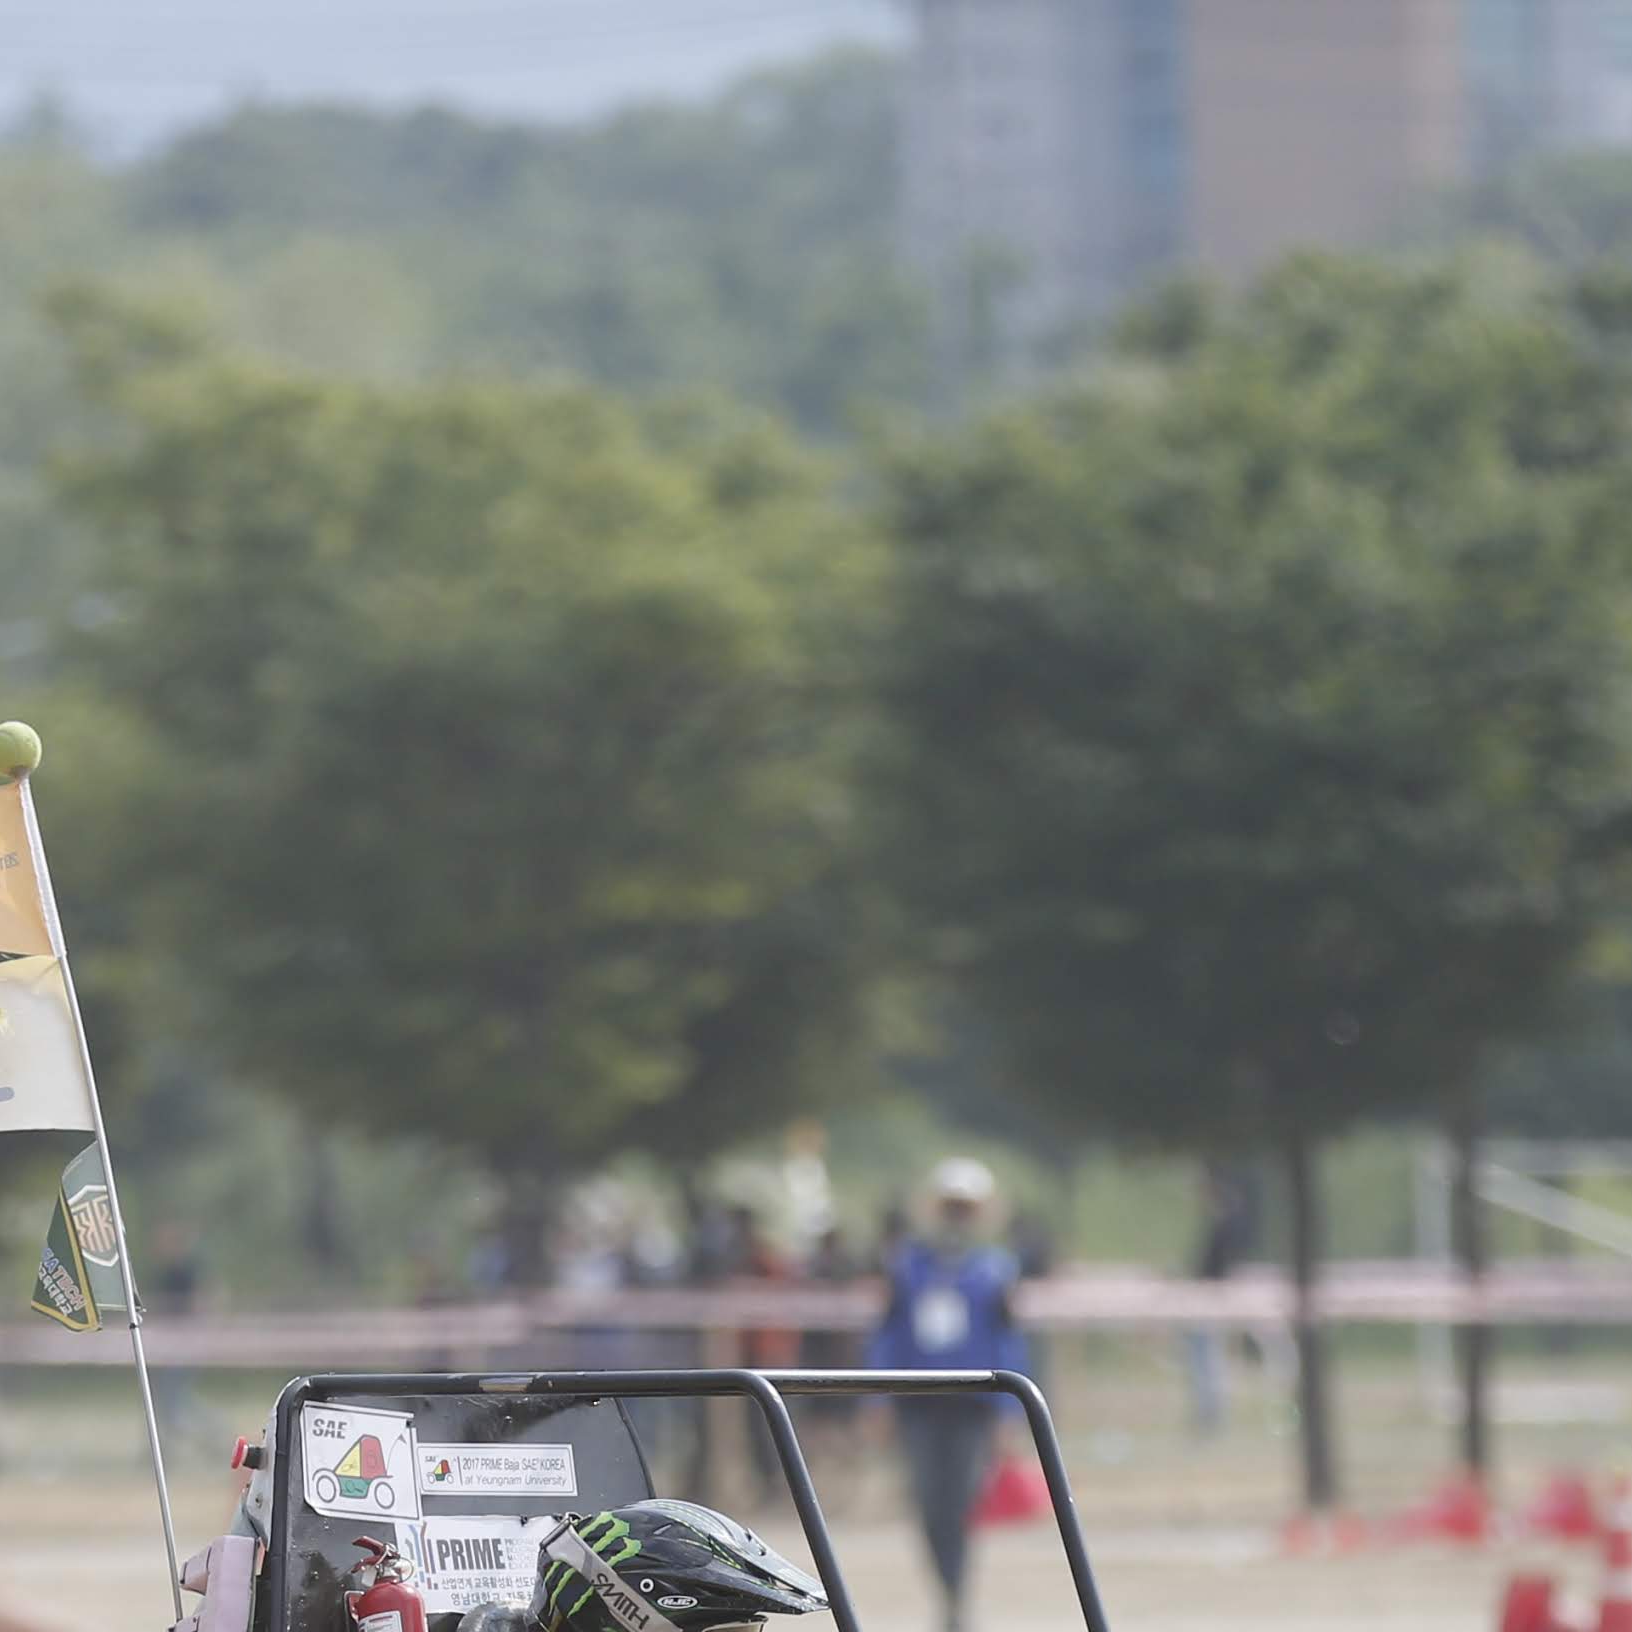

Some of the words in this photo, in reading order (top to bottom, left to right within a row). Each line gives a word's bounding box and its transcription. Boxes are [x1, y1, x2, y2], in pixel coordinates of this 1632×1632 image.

[313, 1418, 348, 1440] SAE
[462, 1457, 479, 1470] 2017
[481, 1457, 503, 1470] PRIME
[505, 1458, 520, 1472] Baja
[540, 1458, 566, 1471] KOREA
[464, 1476, 474, 1485] at
[476, 1475, 523, 1488] Yeungnam
[525, 1476, 567, 1488] University
[436, 1538, 506, 1571] PRIME
[591, 1573, 650, 1631] SMITH
[662, 1597, 692, 1607] HJC
